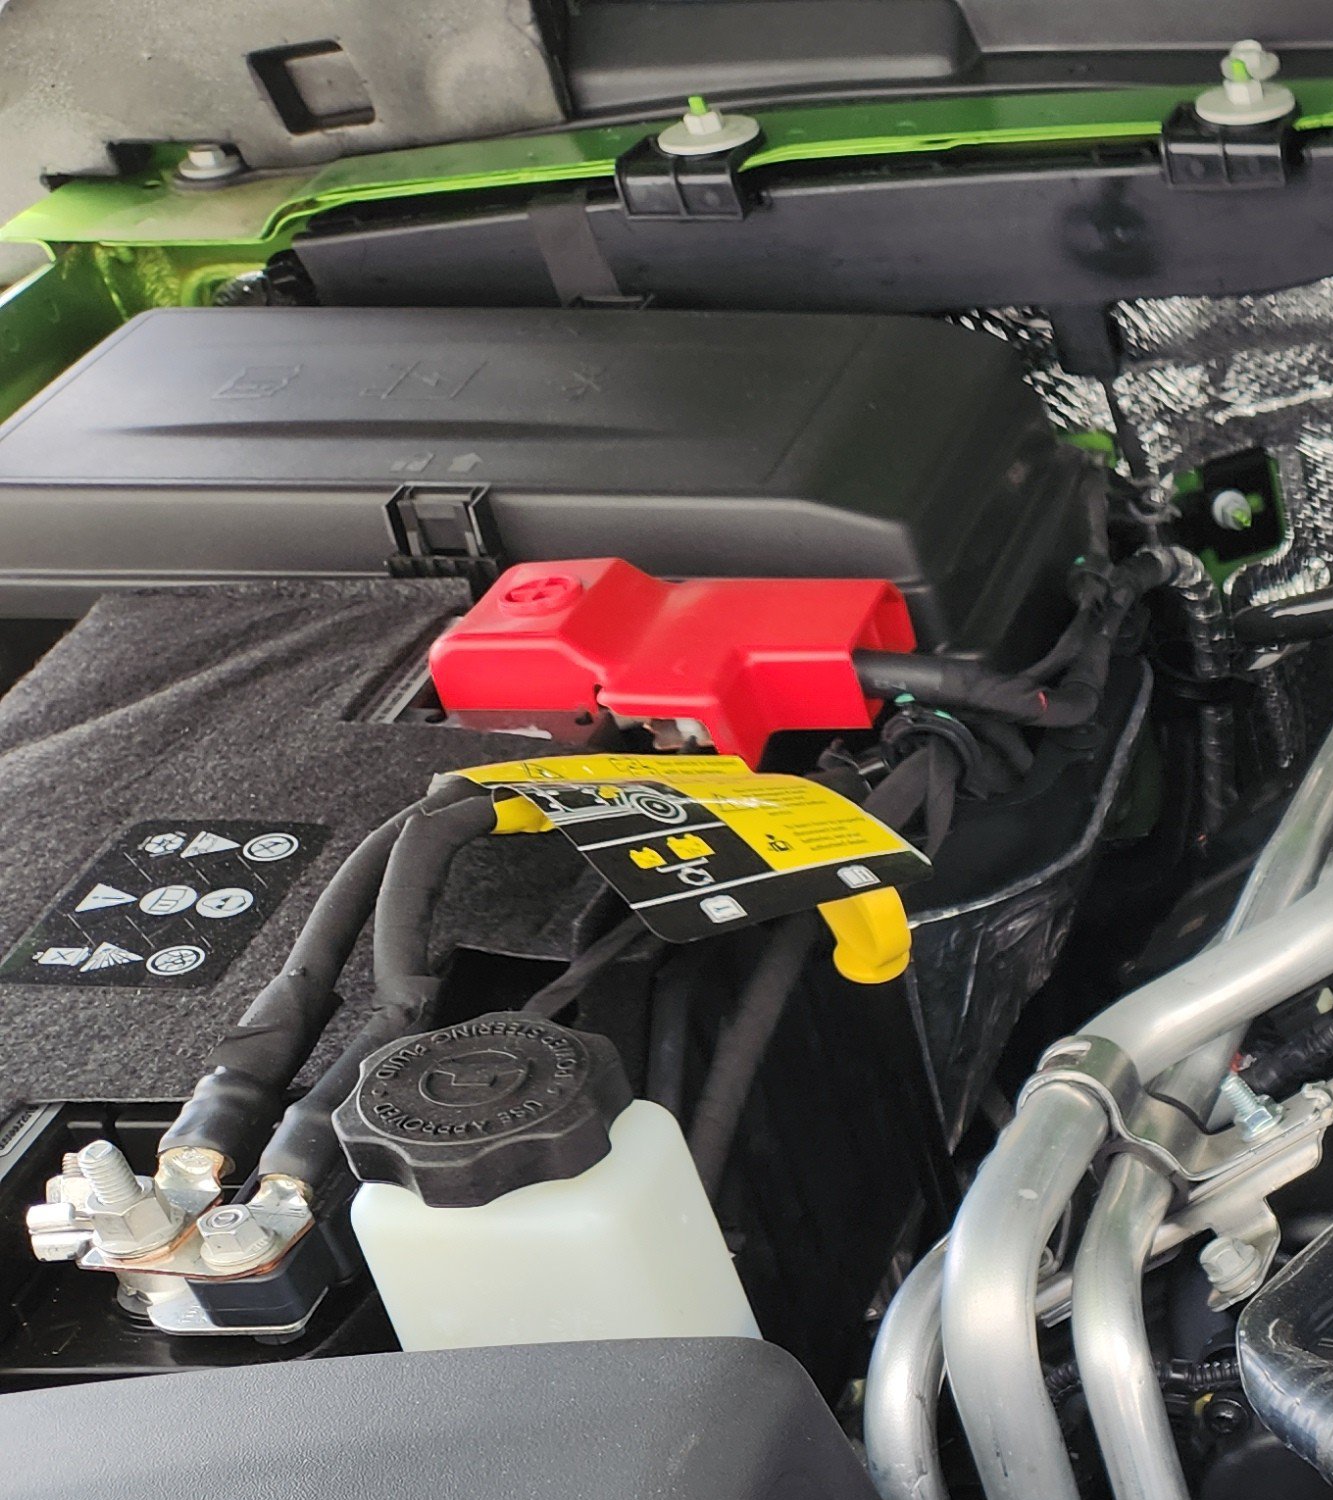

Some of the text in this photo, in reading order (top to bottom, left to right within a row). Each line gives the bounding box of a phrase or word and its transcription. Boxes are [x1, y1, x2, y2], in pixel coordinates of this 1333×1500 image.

[375, 1043, 427, 1080] FLUID
[373, 1099, 543, 1136] USE APPROVED
